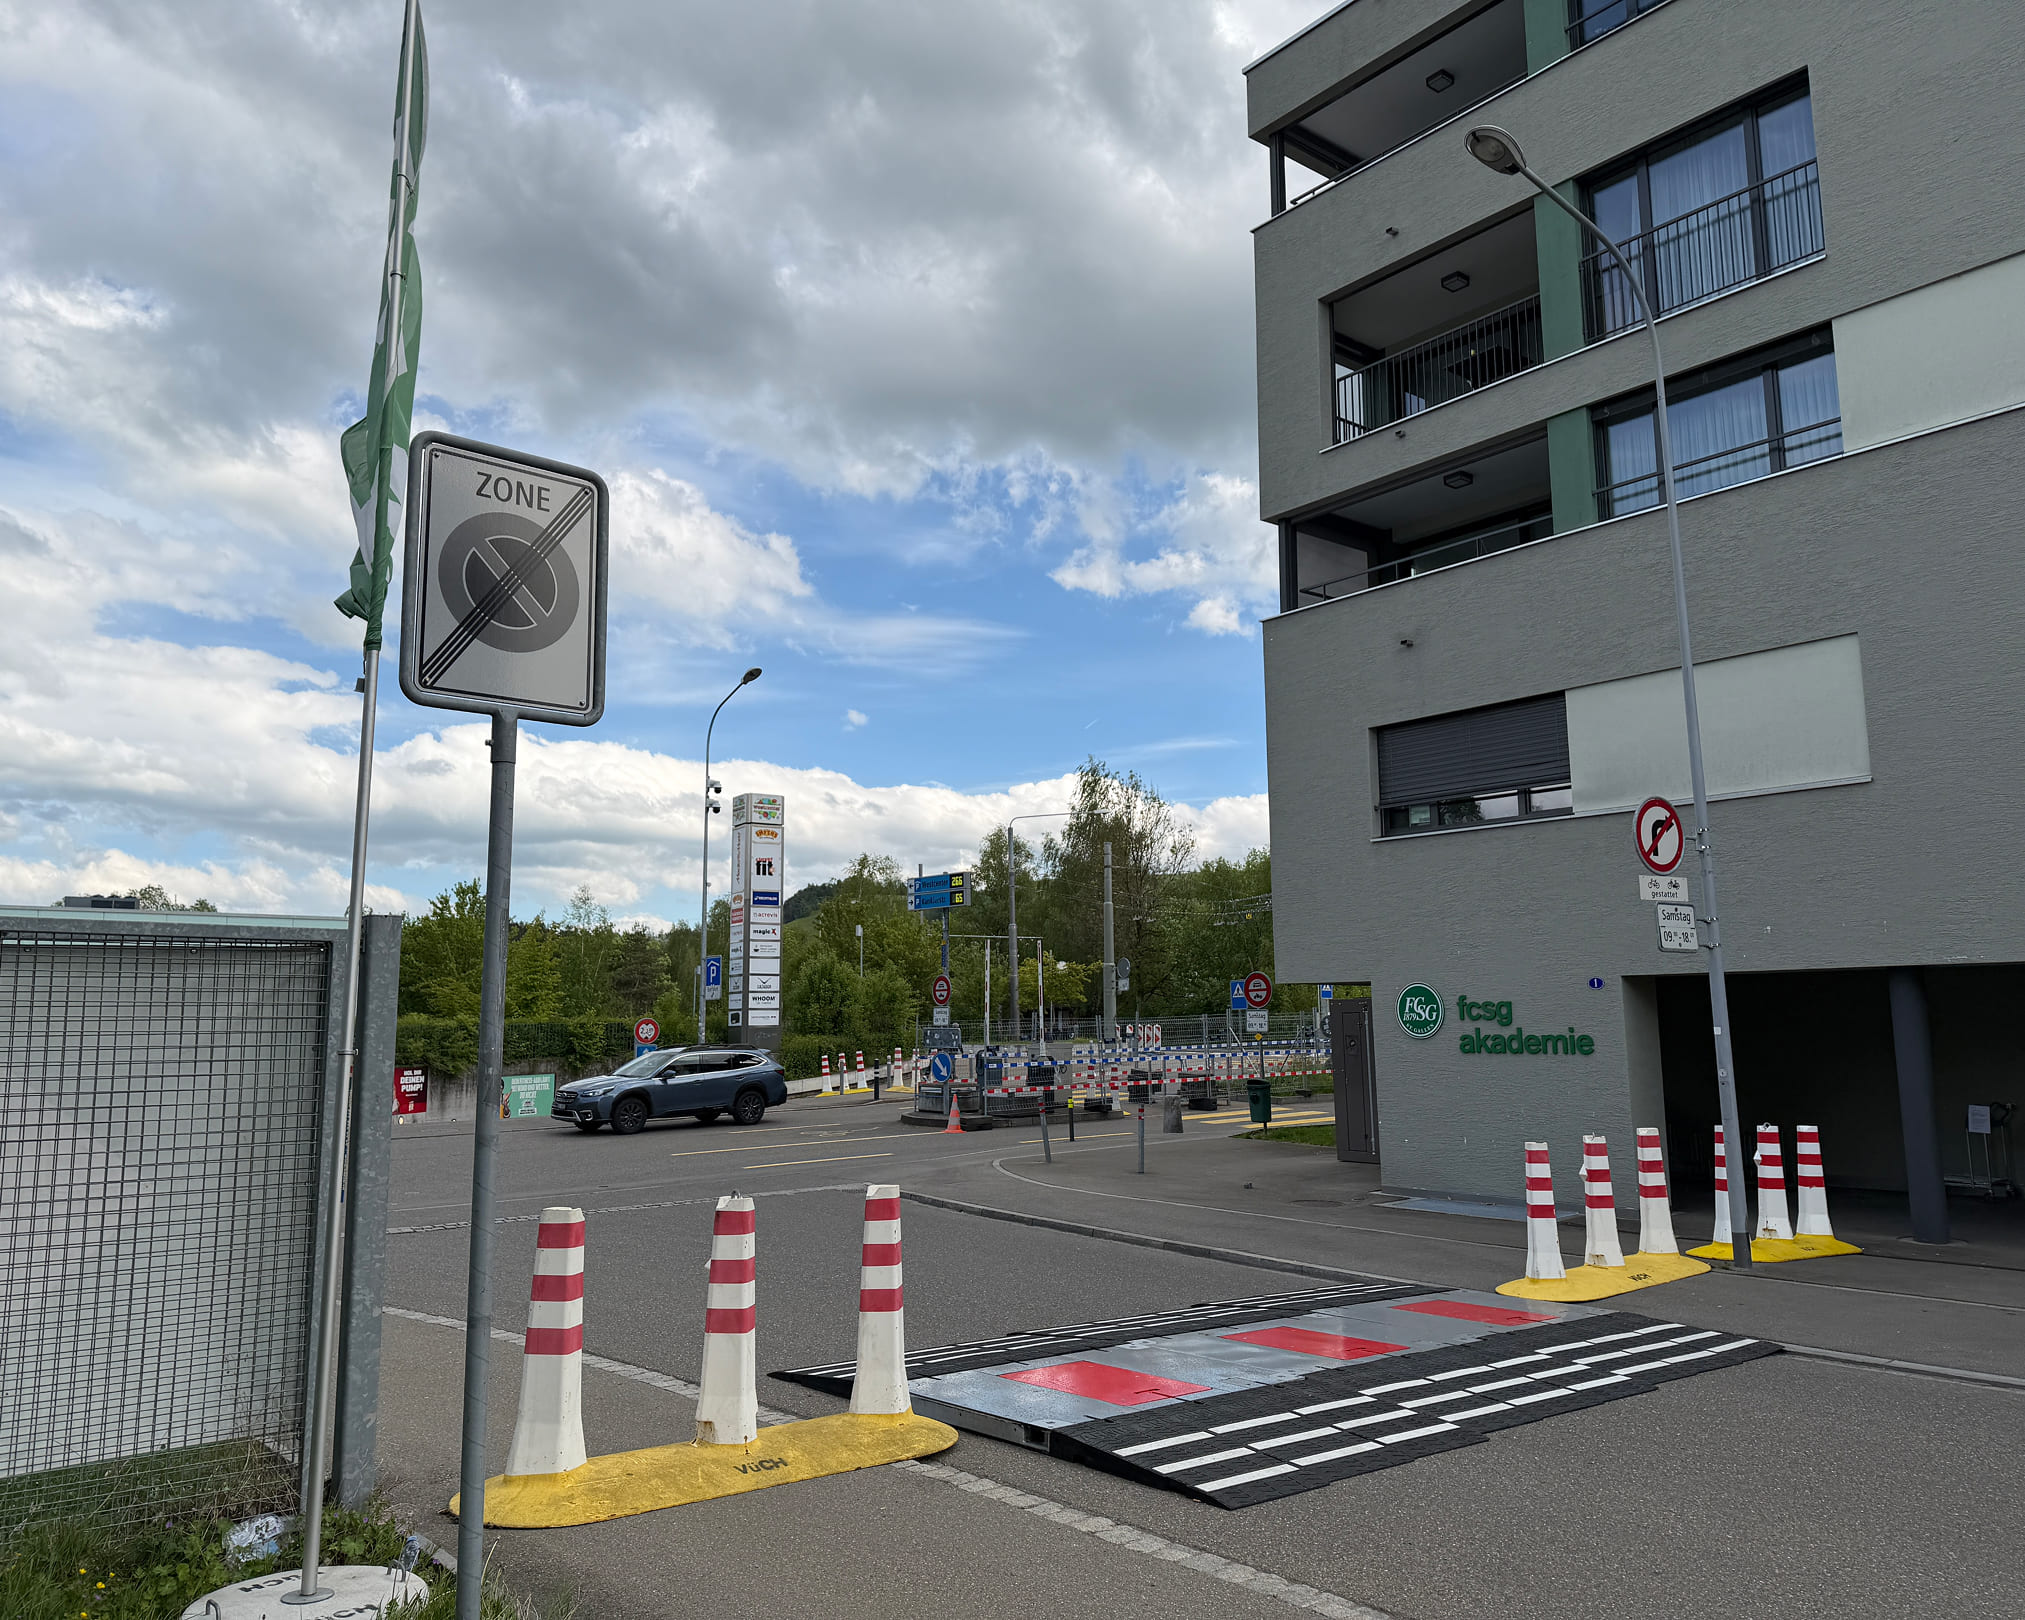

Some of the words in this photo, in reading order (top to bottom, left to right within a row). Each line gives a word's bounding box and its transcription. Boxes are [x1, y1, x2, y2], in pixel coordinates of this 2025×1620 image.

[476, 471, 551, 513] ZONE
[952, 876, 963, 887] 266
[956, 893, 963, 903] 65
[1651, 890, 1678, 899] gestattet
[1661, 909, 1691, 925] Samstag
[1457, 995, 1513, 1026] fcsg
[1459, 1027, 1595, 1055] akademie
[400, 1075, 425, 1084] DEINEN
[401, 1083, 423, 1092] PUMP!
